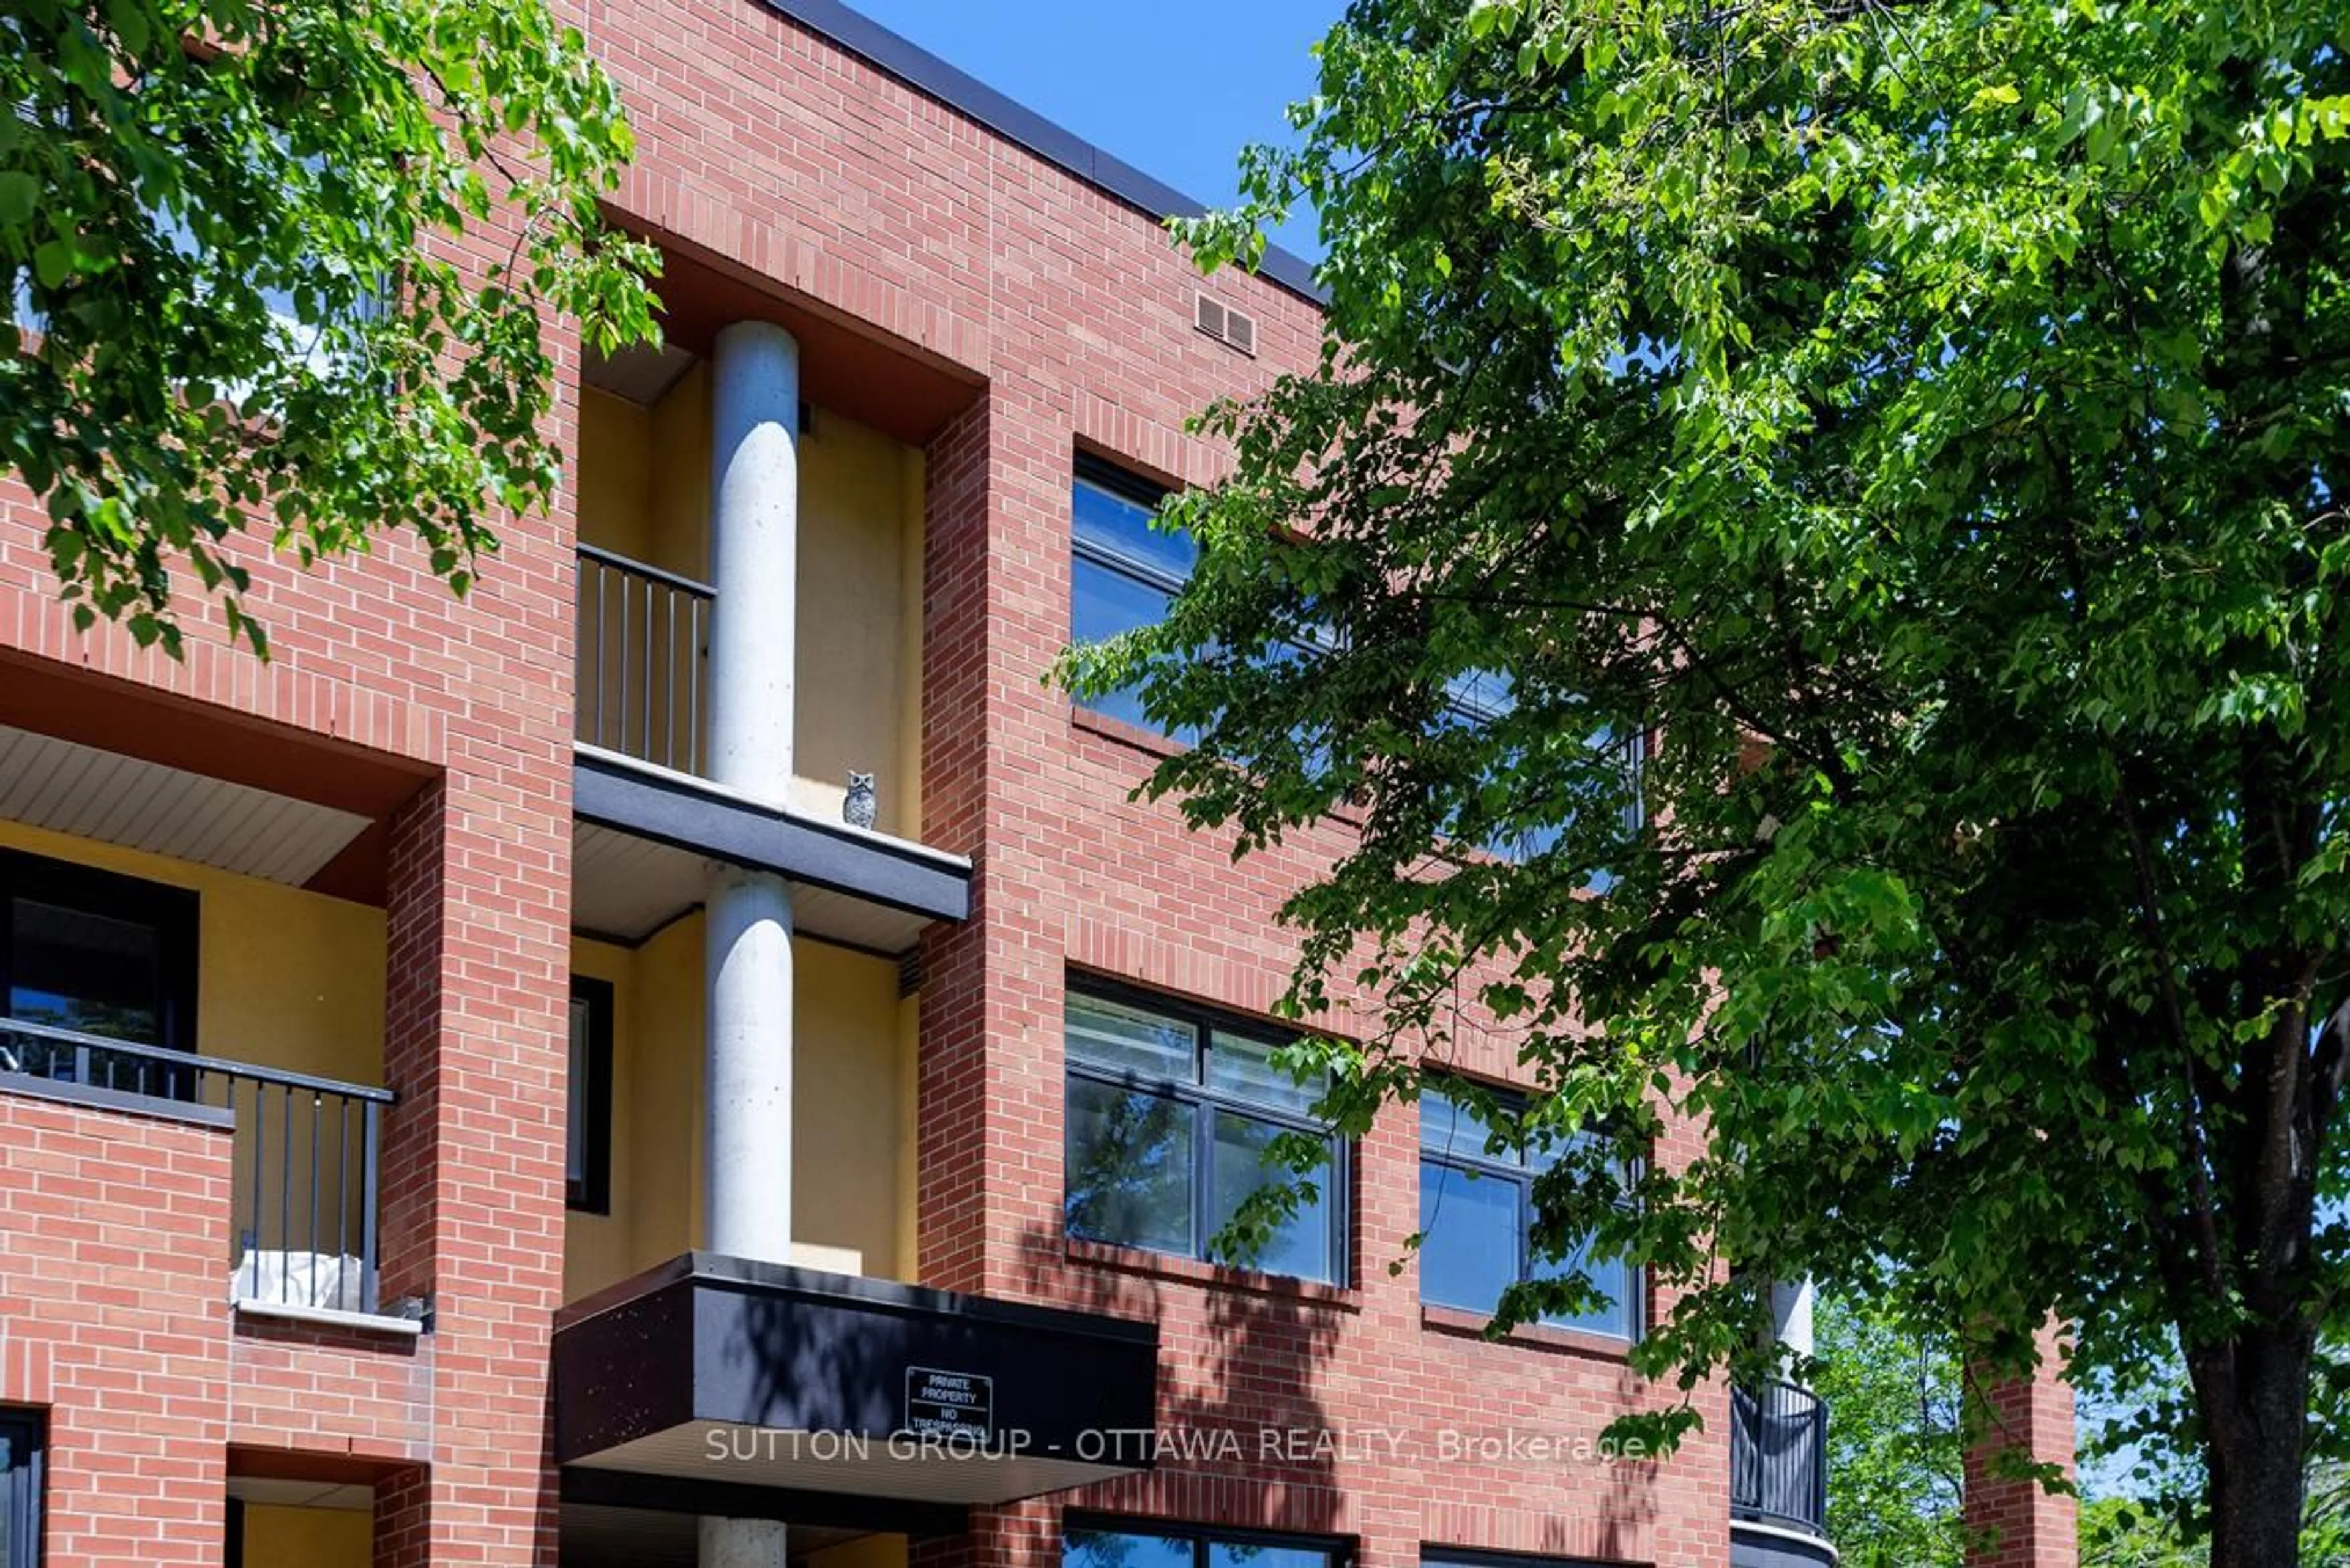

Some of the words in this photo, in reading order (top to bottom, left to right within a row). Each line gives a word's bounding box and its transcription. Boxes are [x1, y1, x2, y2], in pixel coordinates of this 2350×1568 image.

[928, 1375, 970, 1390] PRIVATE
[922, 1387, 977, 1404] PROPERTY
[941, 1408, 958, 1420] NO
